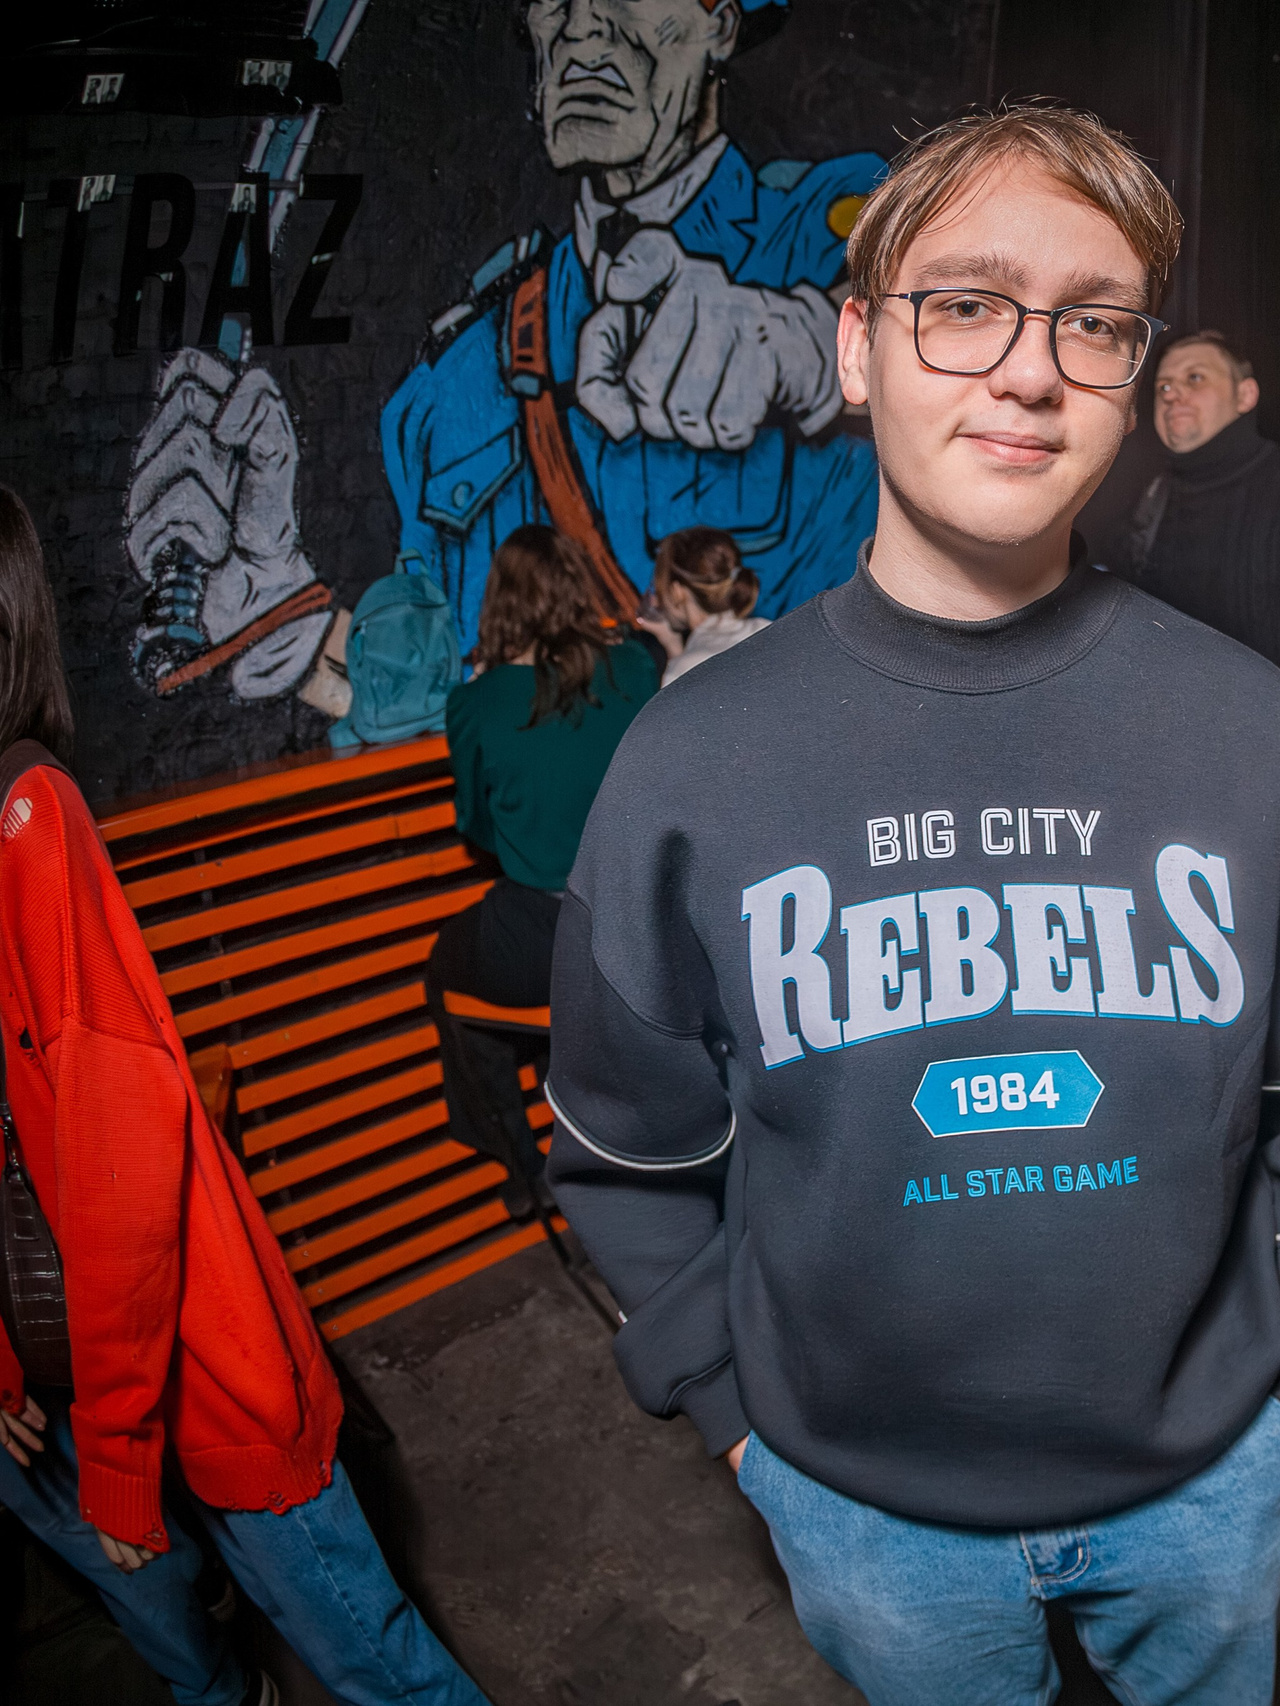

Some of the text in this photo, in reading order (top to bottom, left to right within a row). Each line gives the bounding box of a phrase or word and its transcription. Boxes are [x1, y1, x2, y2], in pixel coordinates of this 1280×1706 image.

[866, 807, 1101, 867] BIG CITY
[741, 843, 1245, 1070] REBELS
[950, 1070, 1061, 1116] 1984
[903, 1155, 1140, 1207] ALL STAR GAME
